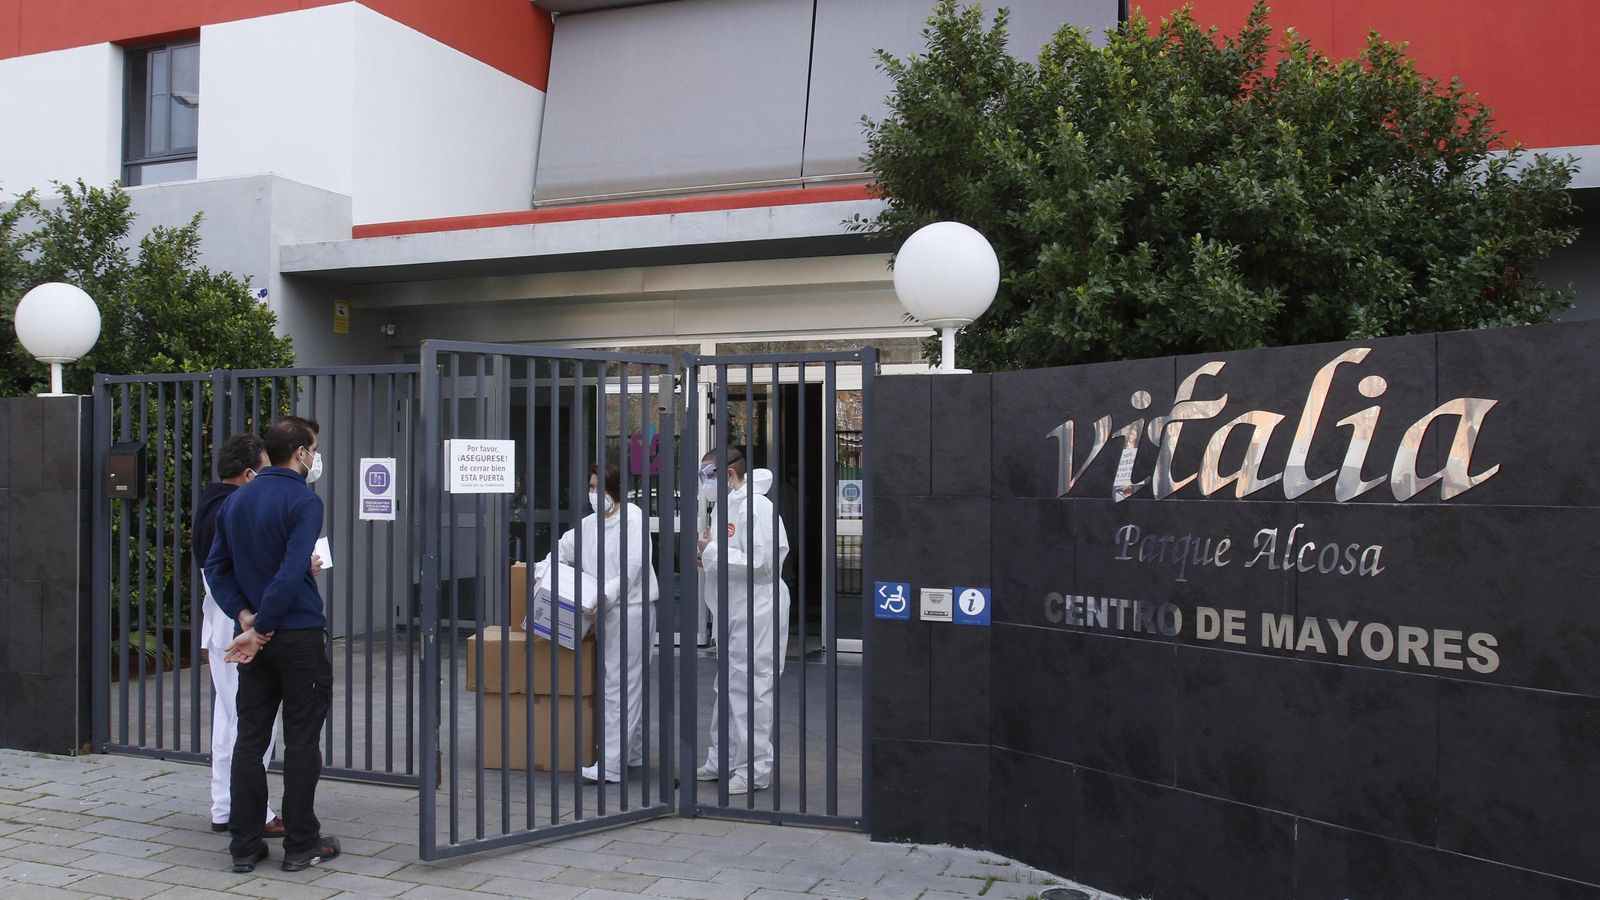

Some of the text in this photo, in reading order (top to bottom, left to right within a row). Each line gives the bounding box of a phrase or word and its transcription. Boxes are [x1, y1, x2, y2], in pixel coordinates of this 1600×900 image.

[1045, 347, 1500, 502] vitalia
[480, 445, 499, 453] favor,
[459, 464, 468, 472] de
[491, 464, 506, 472] bien
[461, 474, 505, 482] ESTA PUERTA
[1114, 523, 1386, 582] Parque Alcosa
[1044, 592, 1500, 674] CENTRO DE MAYORES
